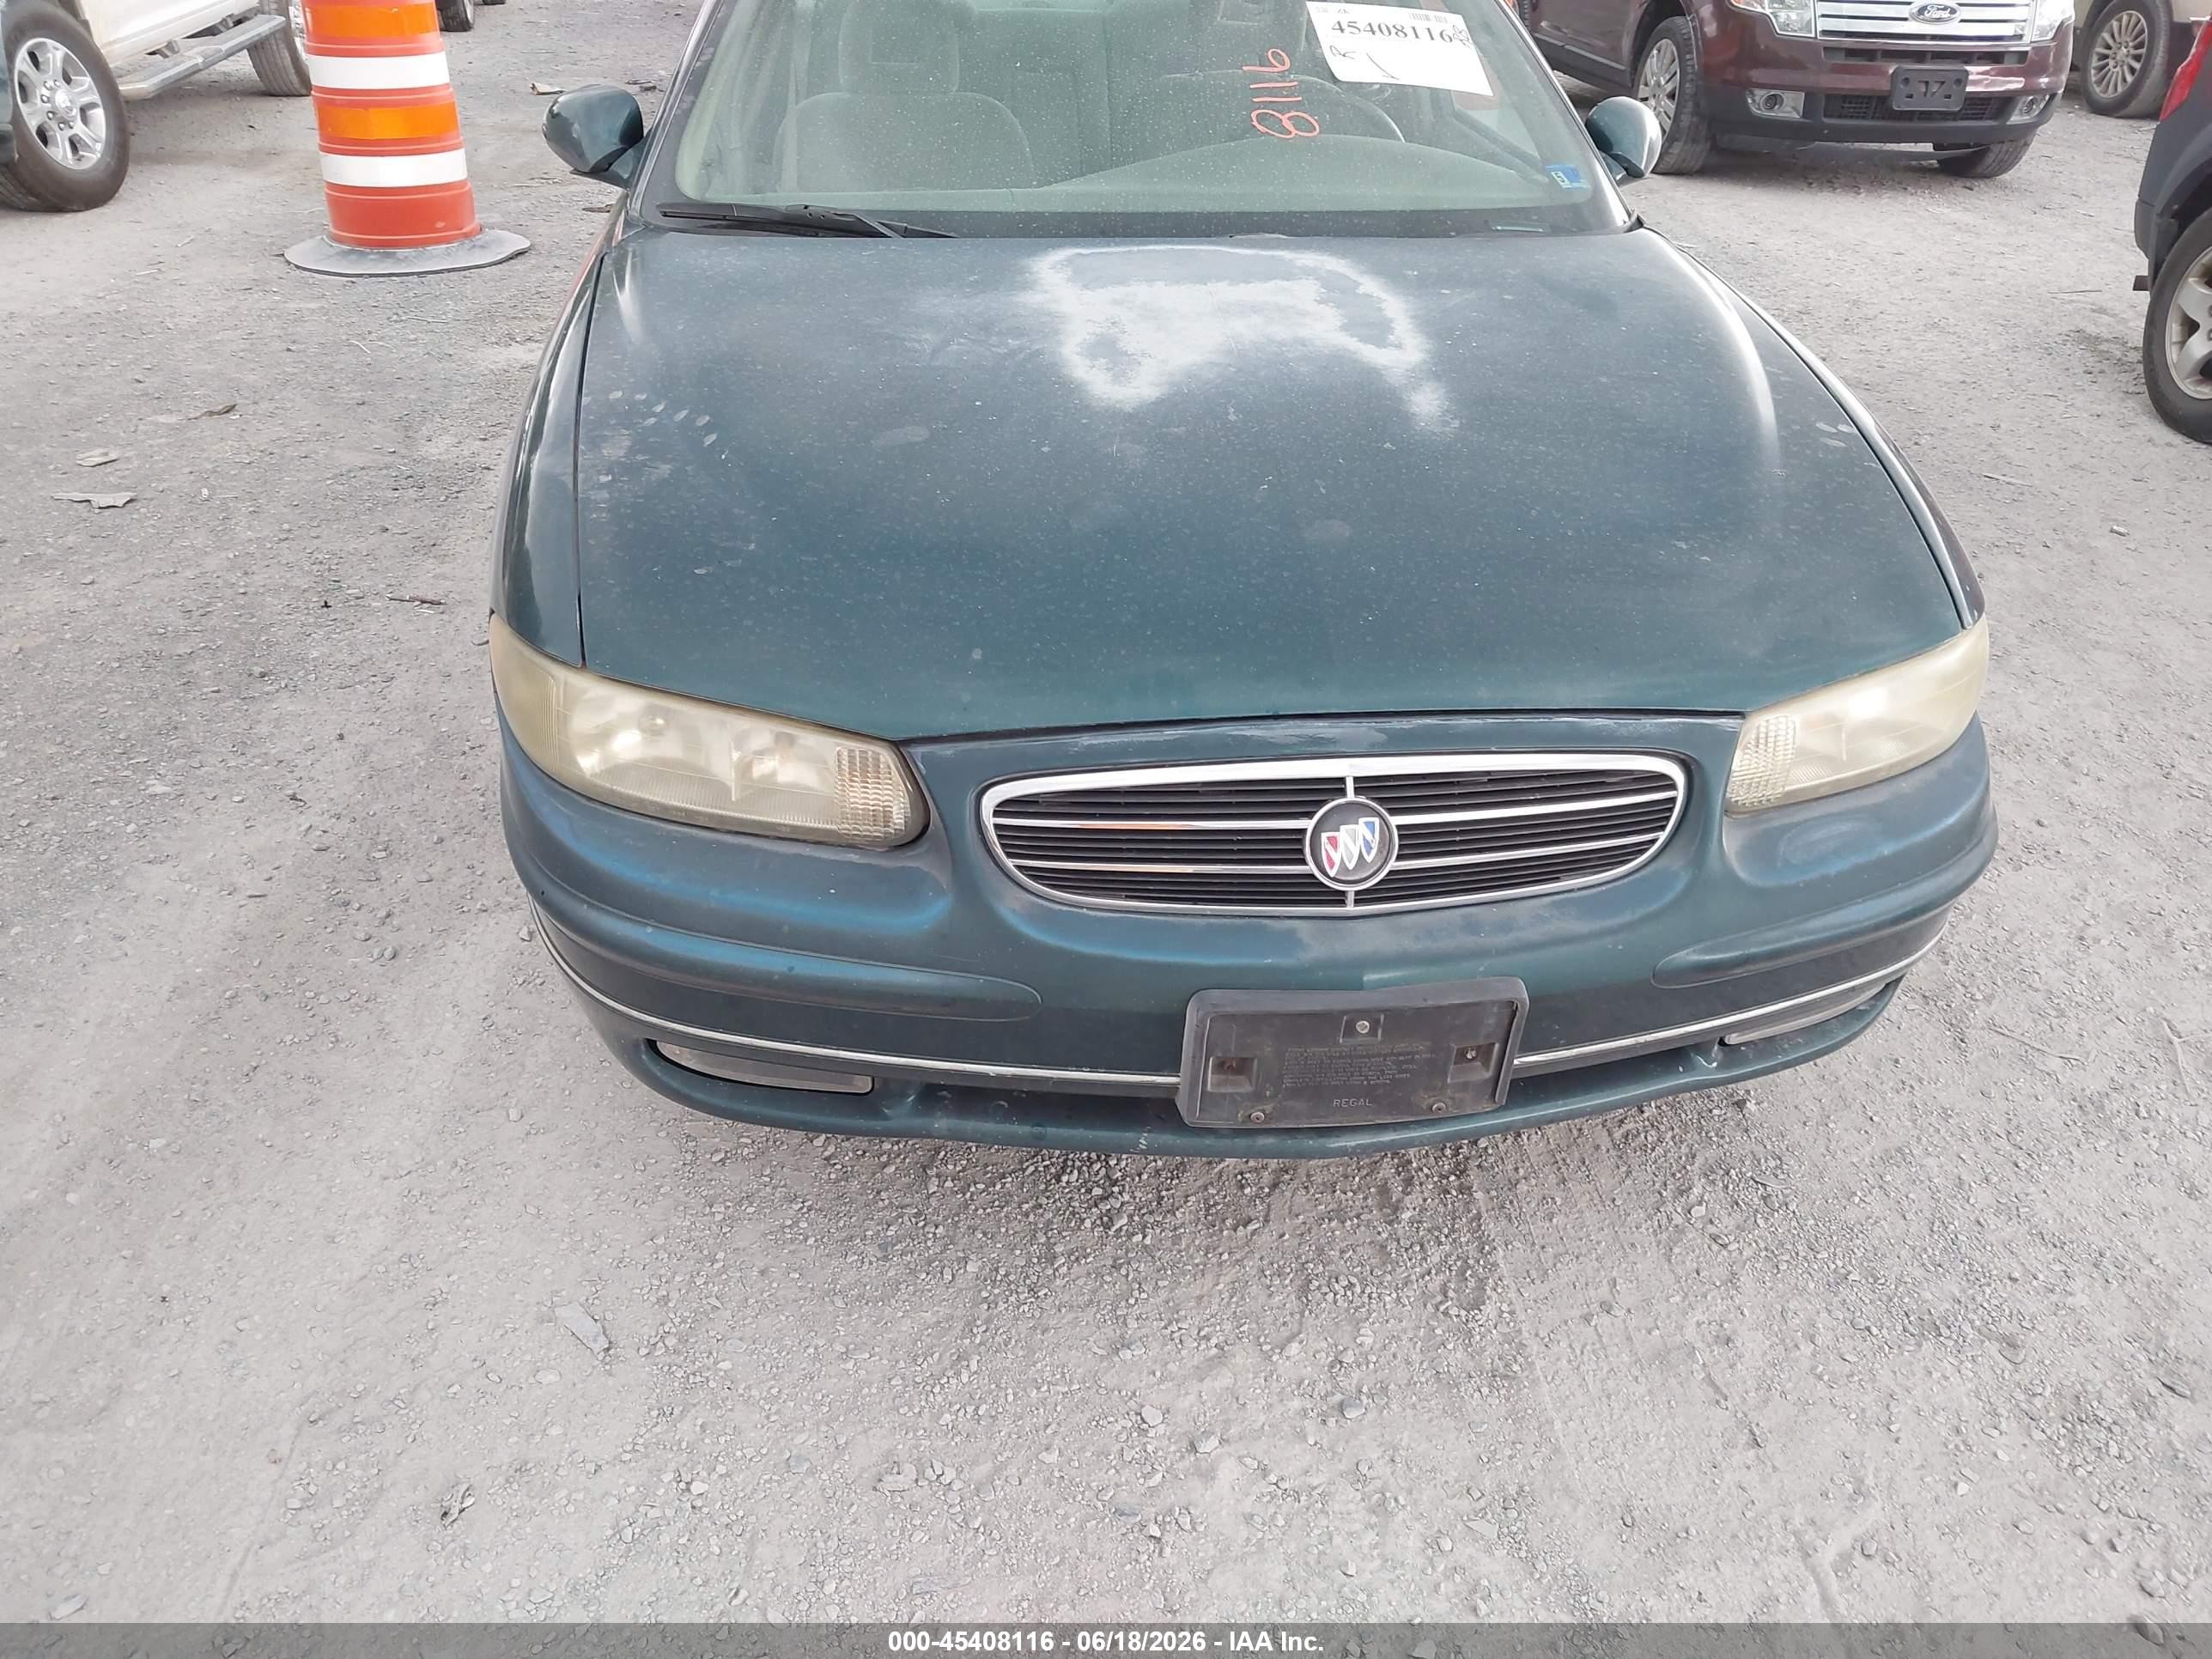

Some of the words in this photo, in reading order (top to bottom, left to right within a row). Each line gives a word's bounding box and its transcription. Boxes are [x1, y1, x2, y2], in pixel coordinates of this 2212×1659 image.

[1923, 3, 1953, 19] Ford
[1331, 19, 1454, 44] 45408116
[1242, 48, 1321, 139] 8116
[1333, 1098, 1374, 1108] REGAL
